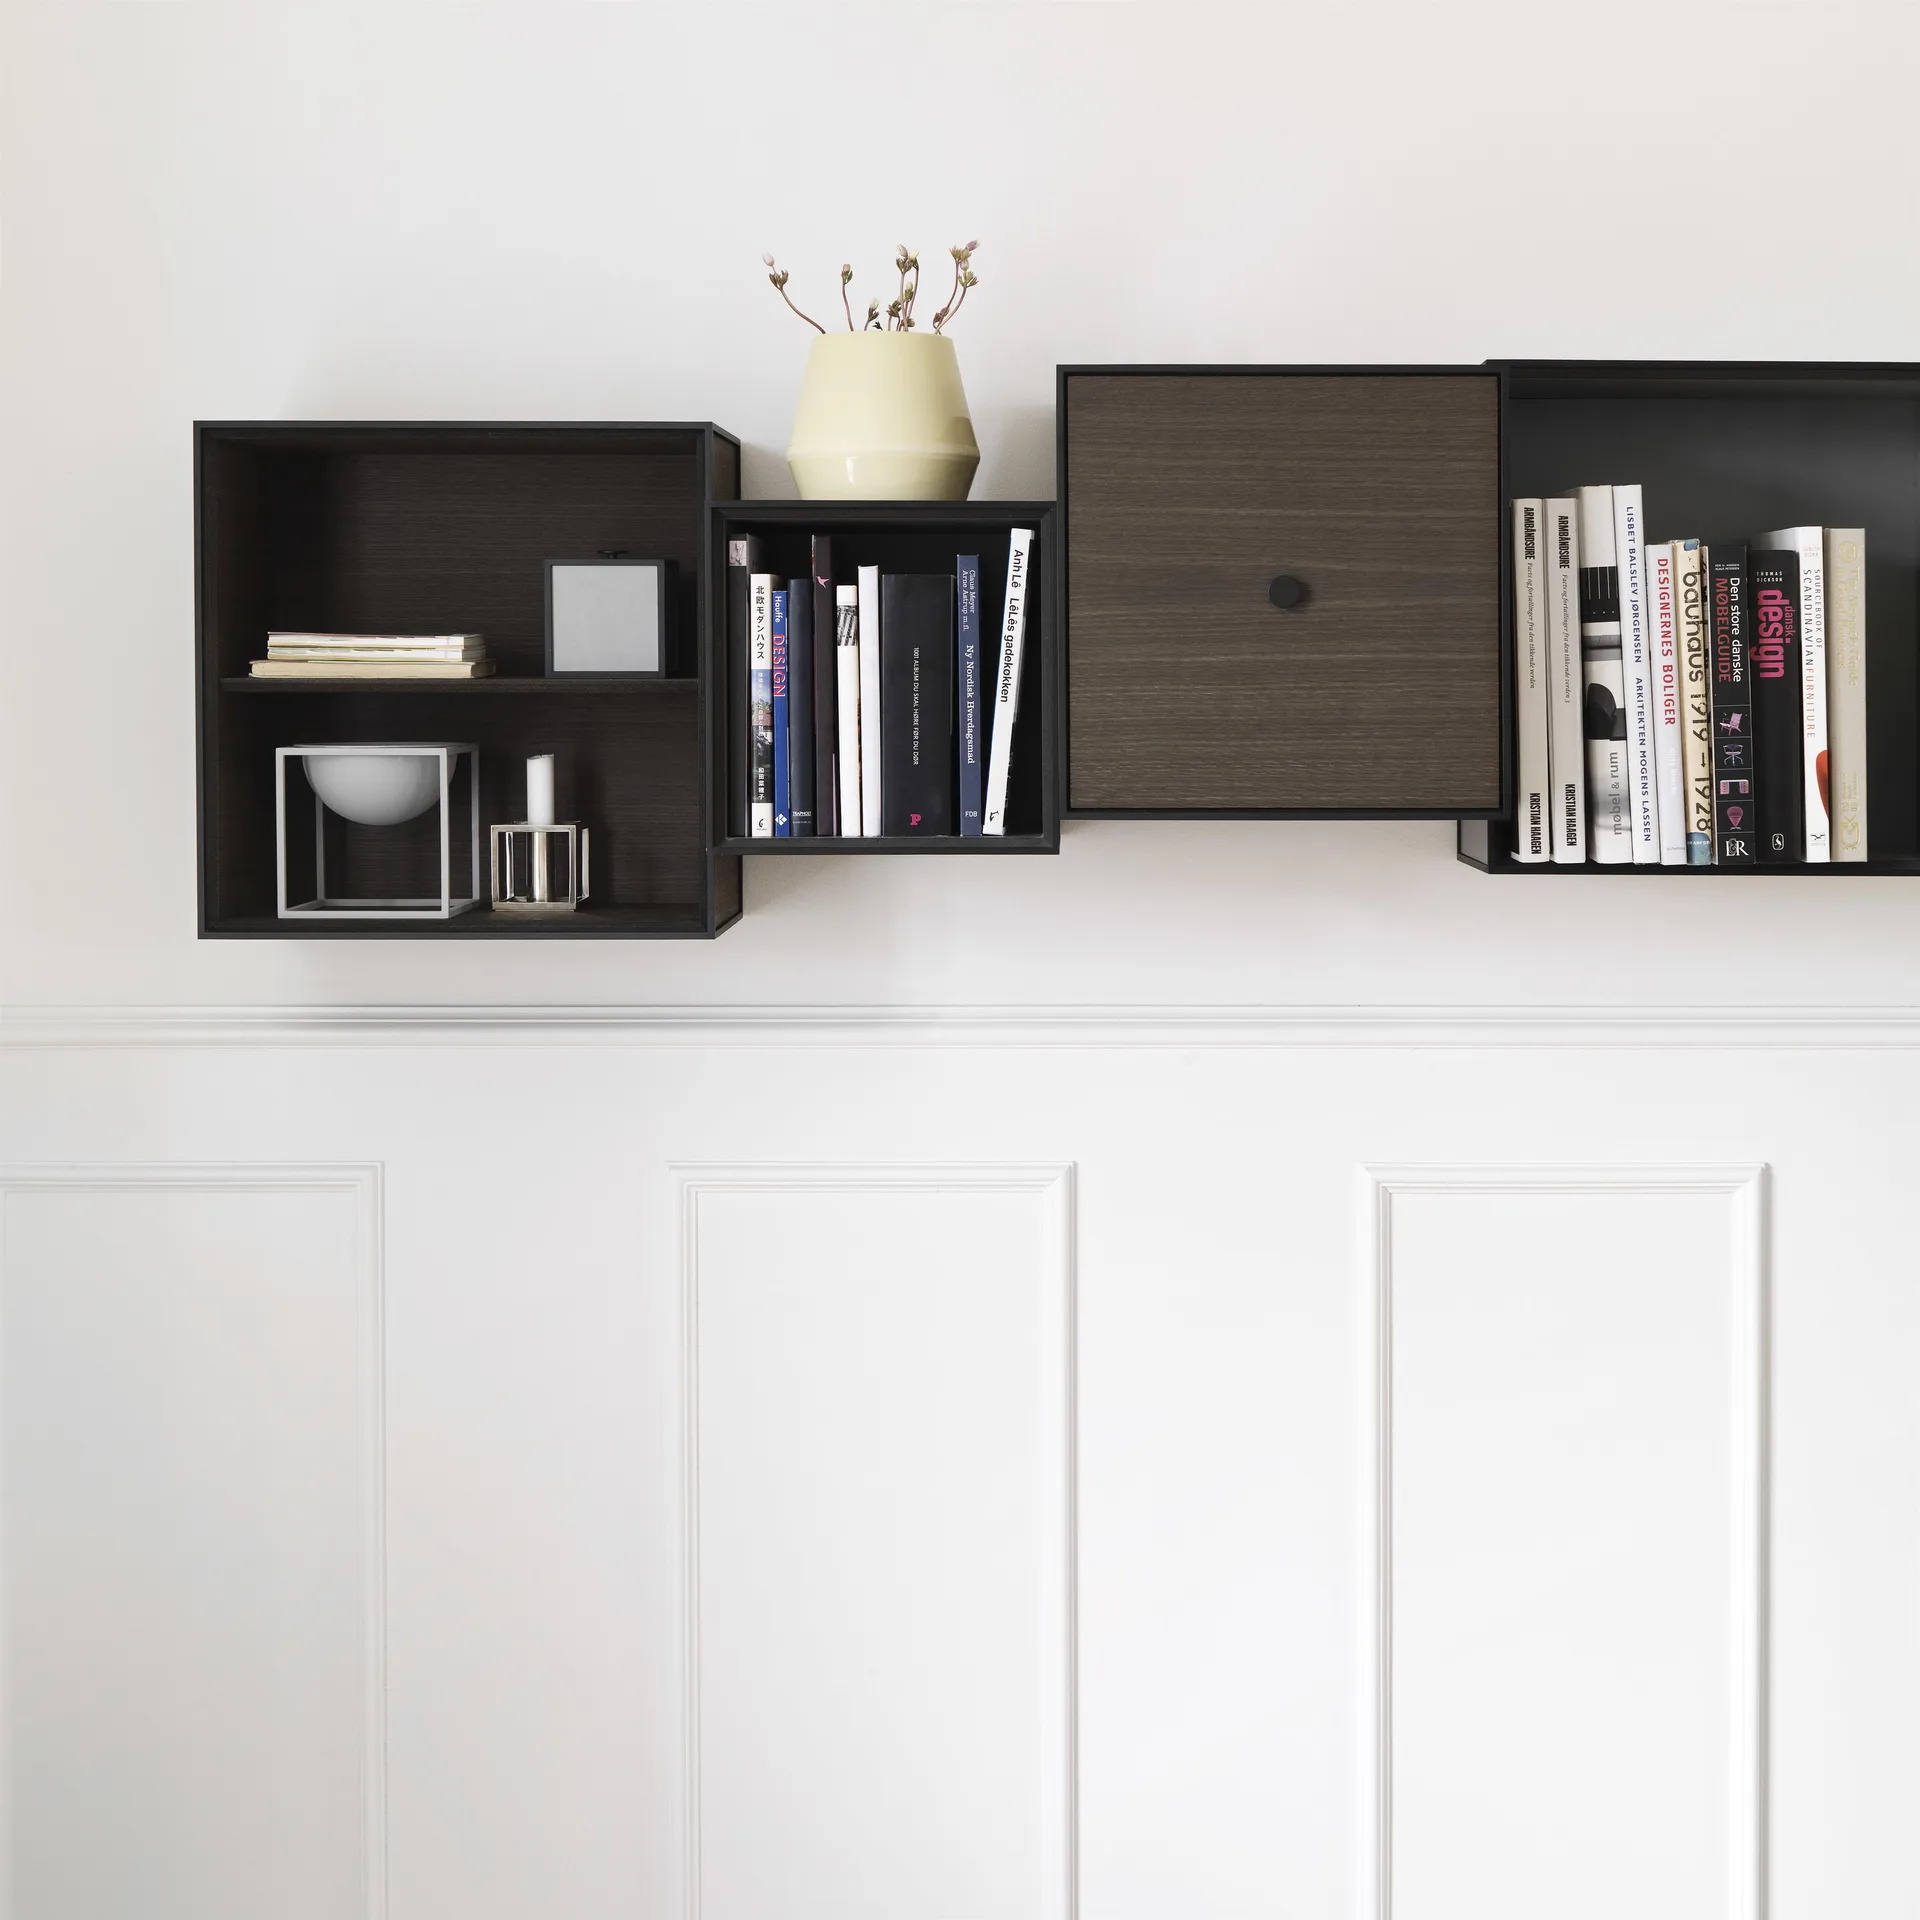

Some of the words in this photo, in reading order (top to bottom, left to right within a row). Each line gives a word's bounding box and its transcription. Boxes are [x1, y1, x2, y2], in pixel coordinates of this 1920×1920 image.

[1523, 507, 1536, 560] ARMBÅNDSURE
[1558, 515, 1571, 569] ARMBÅNDSURE
[1626, 506, 1636, 544] LISBET
[1012, 549, 1024, 572] Anh
[1628, 548, 1638, 595] BALSLEV
[1011, 574, 1022, 588] Lê
[1730, 577, 1740, 602] Den
[774, 595, 783, 623] Hauffe
[968, 591, 976, 613] Meyer
[1007, 597, 1020, 632] LêLês
[1657, 558, 1673, 657] DESIGNERNES
[1814, 569, 1822, 632] SOURCEBOOK
[1630, 599, 1641, 663] JØRGENSEN
[1715, 577, 1731, 683] MØBELGUIDE
[1730, 605, 1741, 636] store
[1750, 589, 1790, 678] design
[1784, 606, 1796, 637] dansk
[965, 645, 974, 659] Ny
[1815, 637, 1823, 648] OF
[772, 633, 786, 697] DESIGN
[1000, 634, 1015, 703] gadekøkken
[1731, 639, 1744, 683] danske
[913, 682, 920, 692] DU
[966, 661, 975, 698] Nordisk
[1662, 664, 1676, 726] BOLIGER
[912, 708, 920, 726] HØRE
[1635, 677, 1646, 745] ARKITEKTEN
[1682, 571, 1704, 683] bauhaus
[1694, 777, 1711, 832] 1928
[912, 727, 920, 740] FØR
[912, 741, 919, 751] DU
[966, 701, 976, 764] Hverdagsmad
[1609, 752, 1619, 778] rum
[1639, 750, 1649, 796] MOGENS
[1565, 783, 1576, 817] KRISTIAN
[1611, 781, 1620, 790] &
[1529, 792, 1541, 825] KRISTIAN
[1608, 793, 1622, 835] møbel
[1642, 800, 1651, 842] LASSEN
[1530, 826, 1542, 855] HAAGEN
[1566, 818, 1577, 847] HAAGEN
